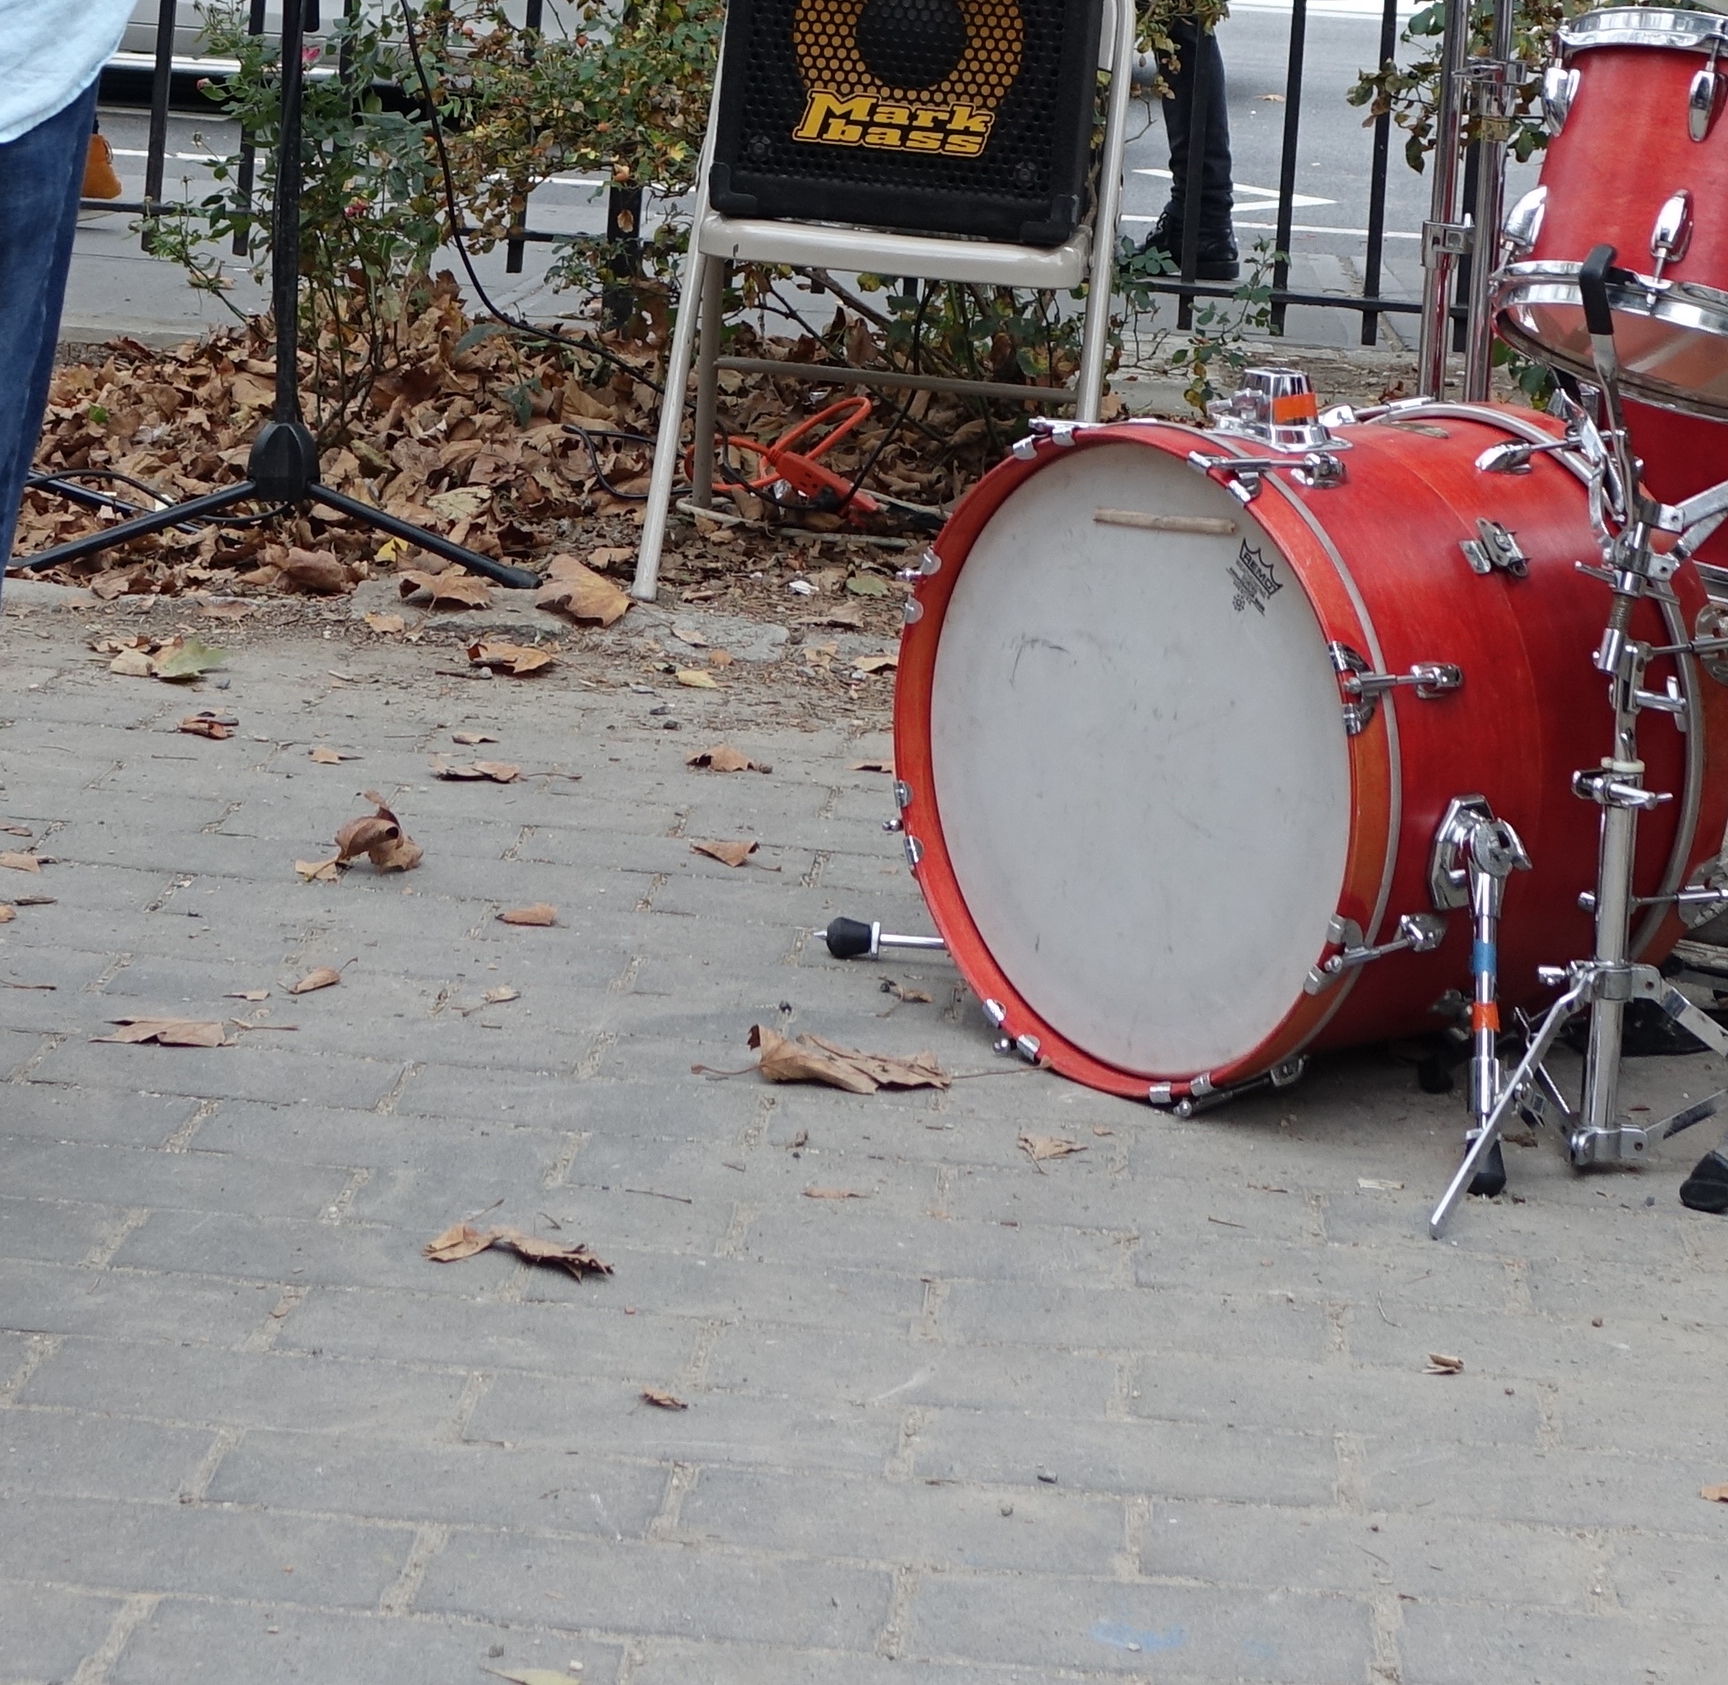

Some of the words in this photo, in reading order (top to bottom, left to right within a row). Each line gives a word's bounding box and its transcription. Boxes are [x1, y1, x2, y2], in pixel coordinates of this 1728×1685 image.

[796, 92, 991, 138] Mark
[822, 118, 983, 153] bass
[1243, 552, 1274, 590] REMO
